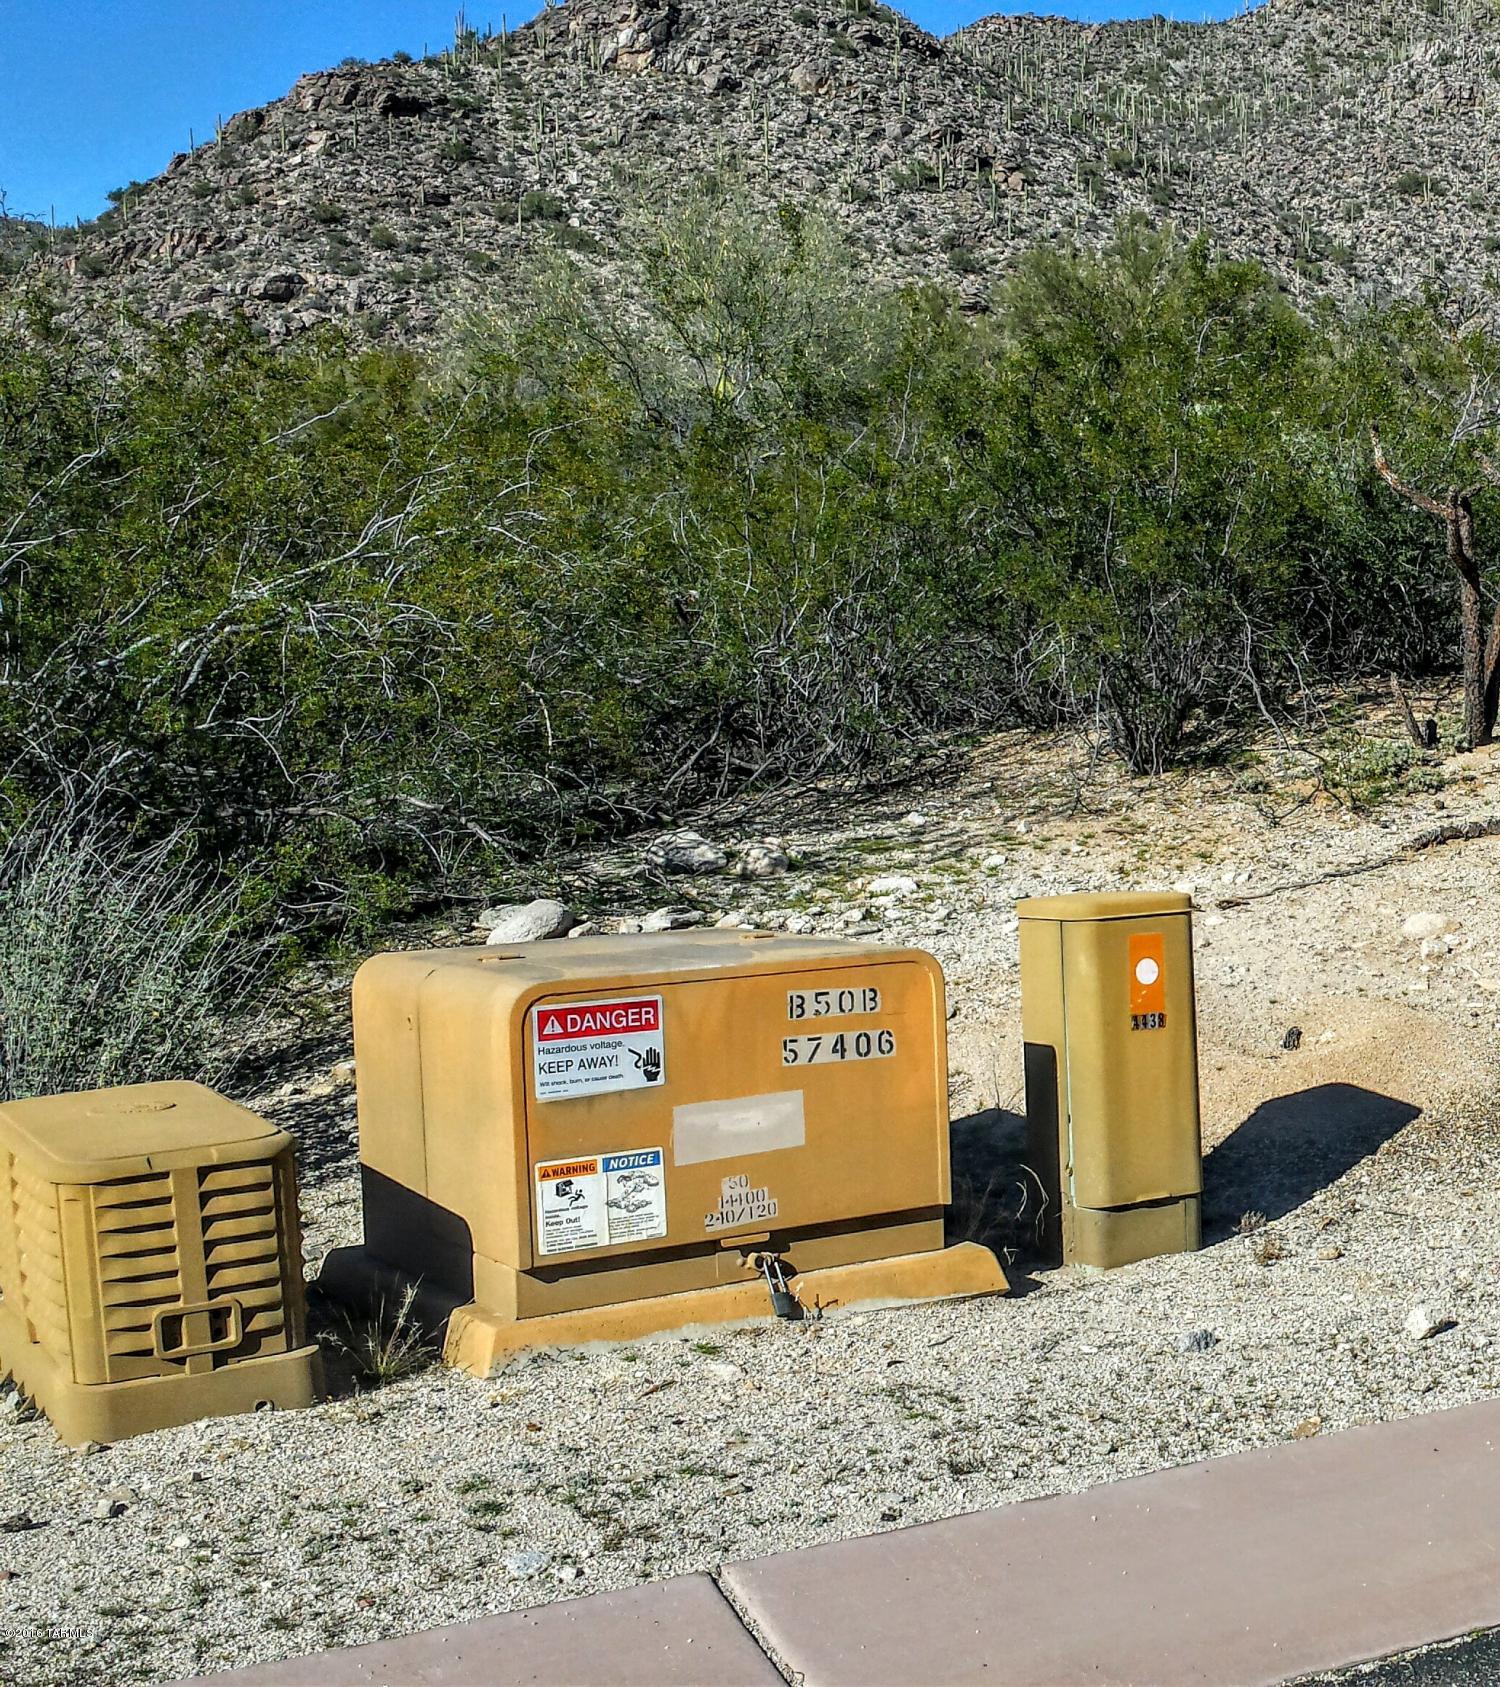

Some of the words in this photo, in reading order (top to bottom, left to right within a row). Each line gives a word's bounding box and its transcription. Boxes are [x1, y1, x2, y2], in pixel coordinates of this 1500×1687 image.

[789, 988, 879, 1019] B50B
[567, 1007, 655, 1033] DANGER
[538, 1044, 588, 1056] Hazardous
[589, 1040, 626, 1050] voltage.
[783, 1029, 895, 1064] 57406
[538, 1059, 574, 1075] KEEP
[577, 1054, 619, 1071] AWAY!
[552, 1162, 596, 1177] WARNING
[609, 1153, 655, 1169] NOTICE
[729, 1175, 748, 1189] 50
[565, 1216, 581, 1224] Out!
[705, 1202, 776, 1227] 240/120
